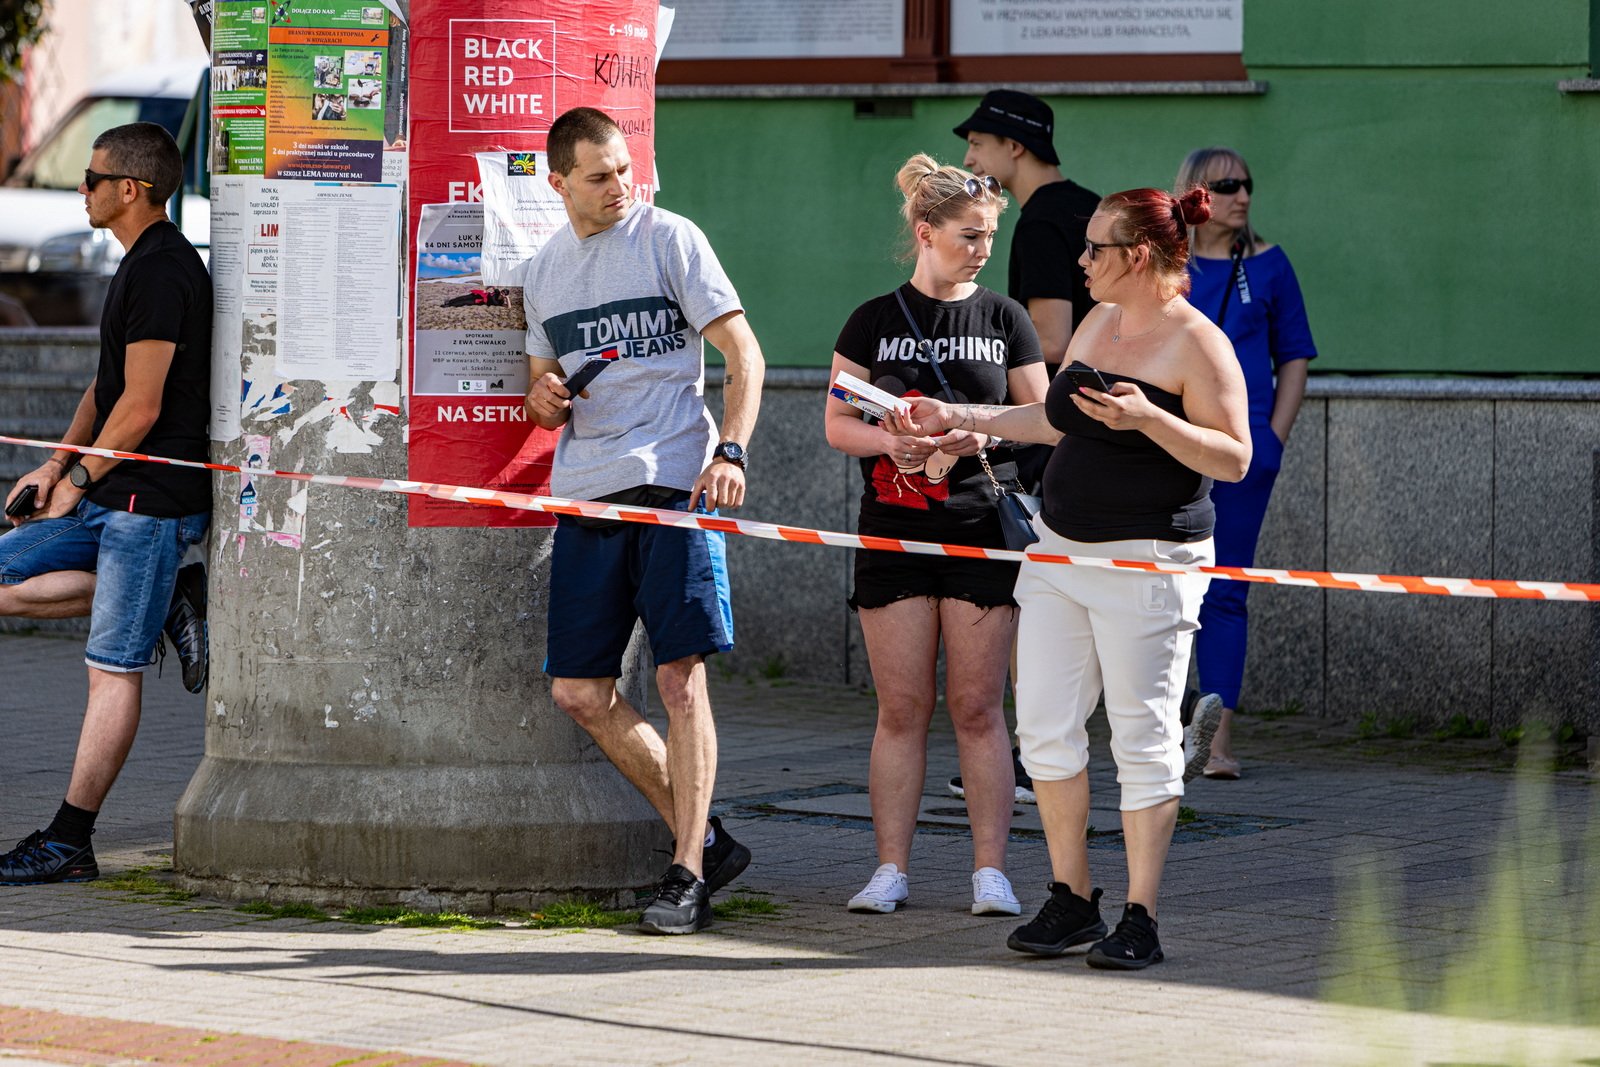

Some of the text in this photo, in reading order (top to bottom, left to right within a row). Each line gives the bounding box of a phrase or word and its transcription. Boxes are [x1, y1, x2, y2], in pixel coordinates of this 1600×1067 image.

[609, 24, 615, 36] 6
[624, 24, 633, 37] 19
[634, 26, 648, 40] maja
[465, 38, 543, 59] BLACK
[465, 66, 514, 86] RED
[463, 94, 543, 114] WHITE
[302, 170, 321, 178] LEMA
[577, 309, 679, 348] TOMMY
[621, 333, 686, 359] JEANS
[877, 336, 1005, 365] MOSCHINO
[438, 406, 468, 422] NA
[246, 506, 252, 515] 4
